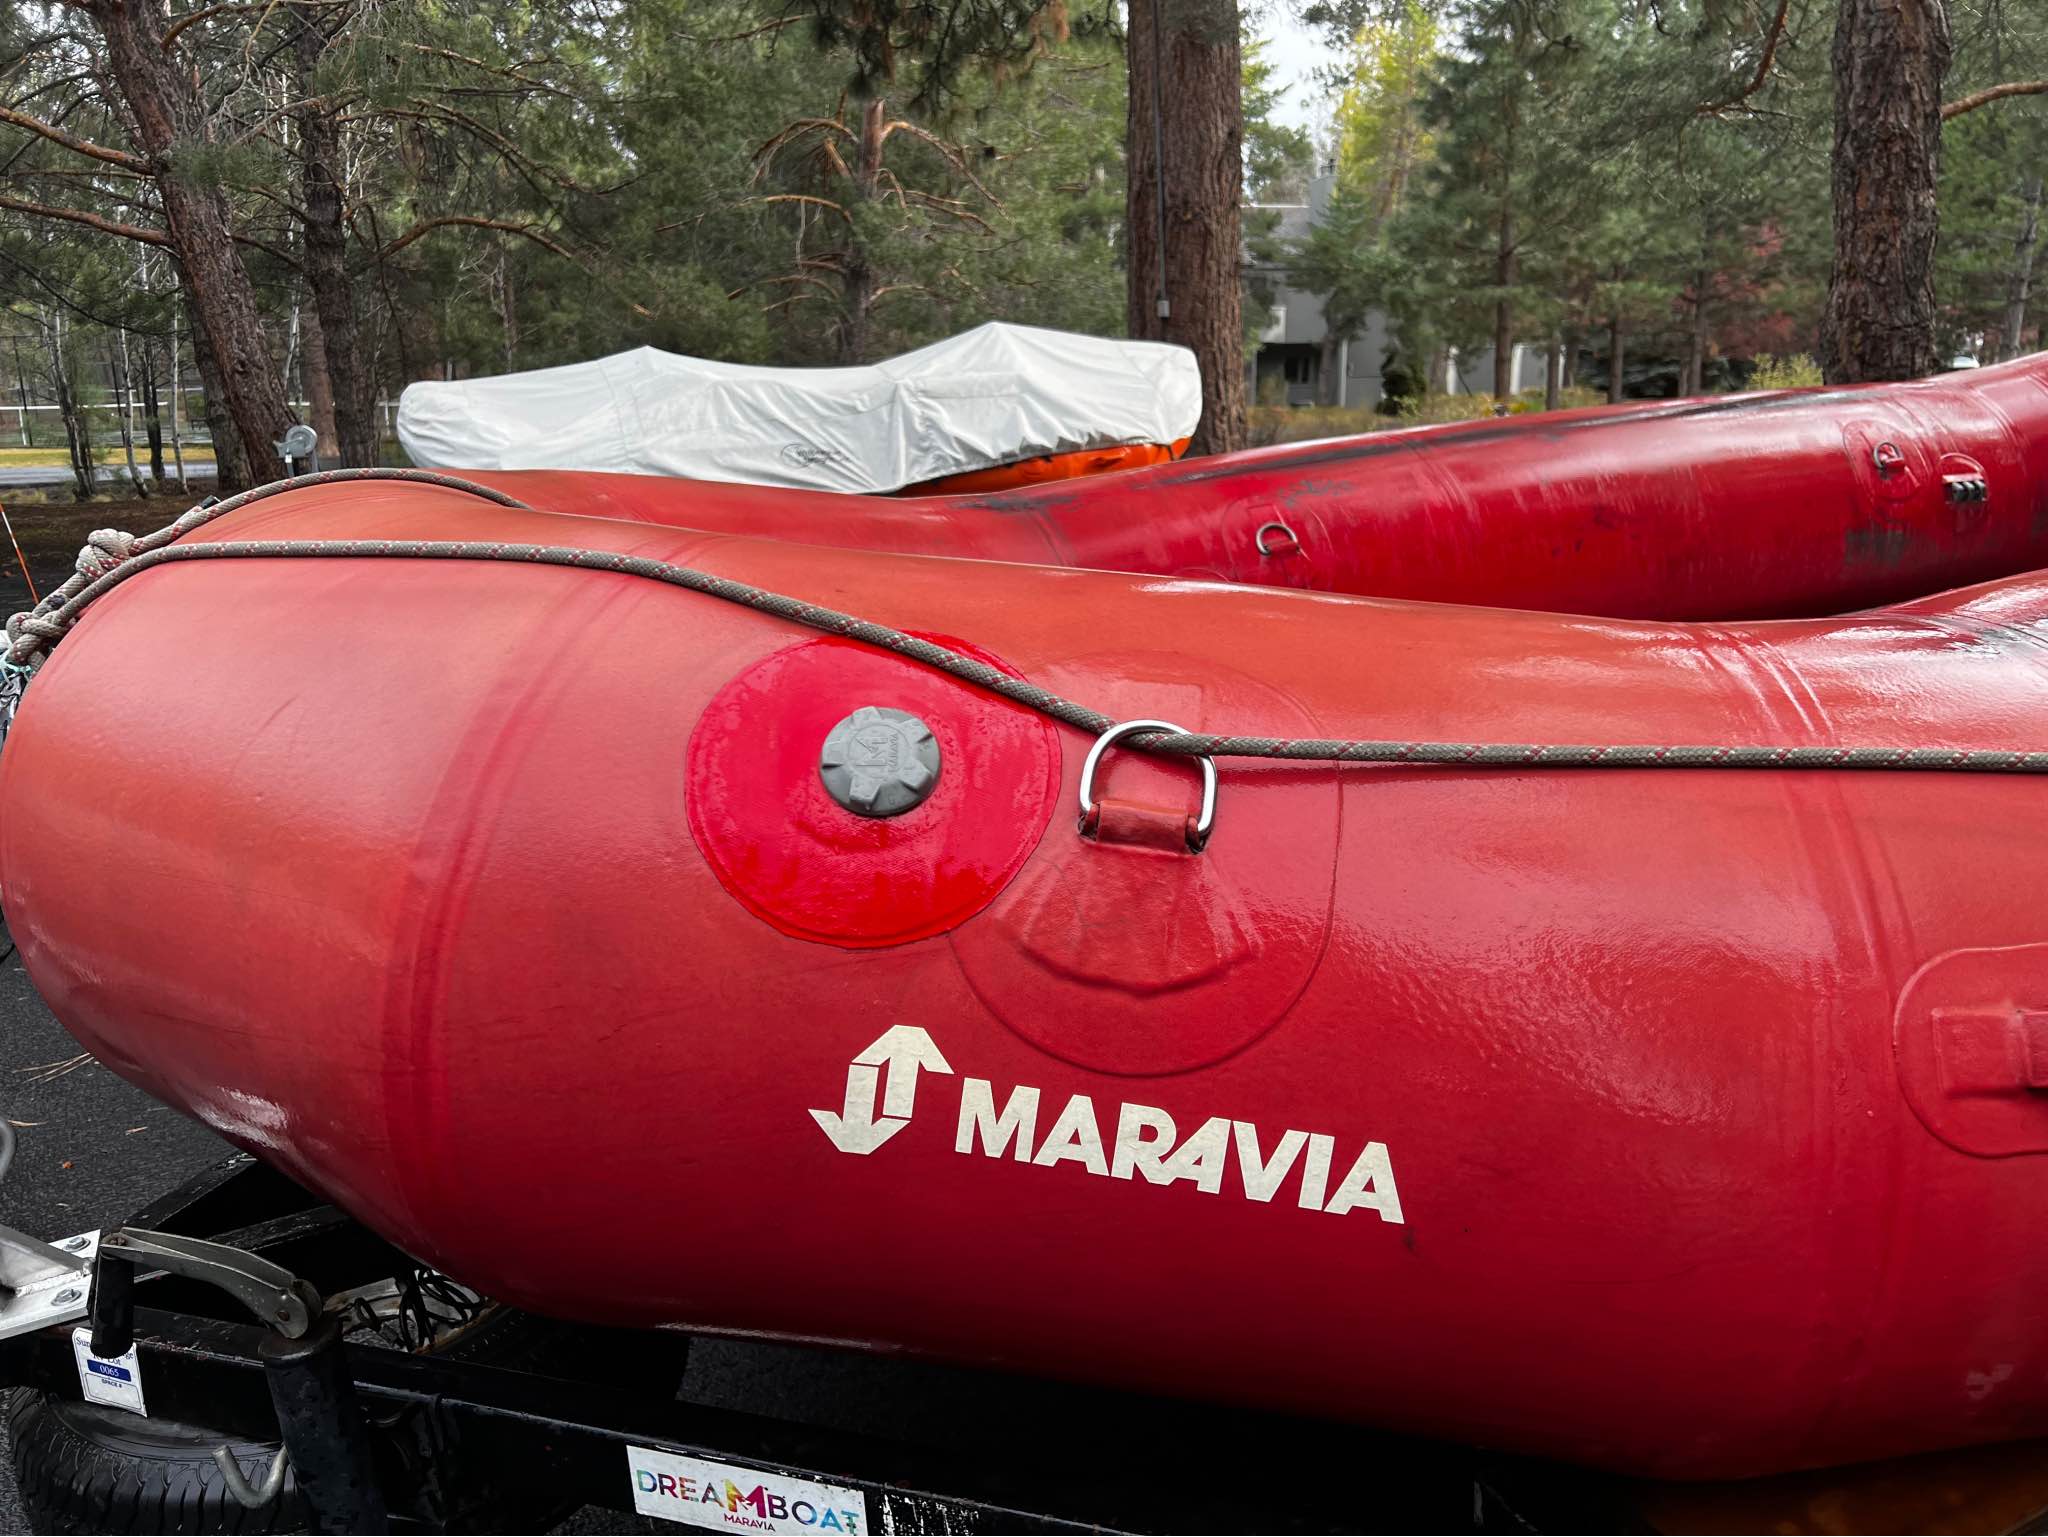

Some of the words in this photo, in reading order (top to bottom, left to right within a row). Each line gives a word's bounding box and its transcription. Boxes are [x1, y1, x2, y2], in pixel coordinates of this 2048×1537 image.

[954, 1077, 1405, 1224] MARAVIA
[636, 1469, 860, 1536] DREAMBOAT
[723, 1512, 776, 1532] MARAVIA
